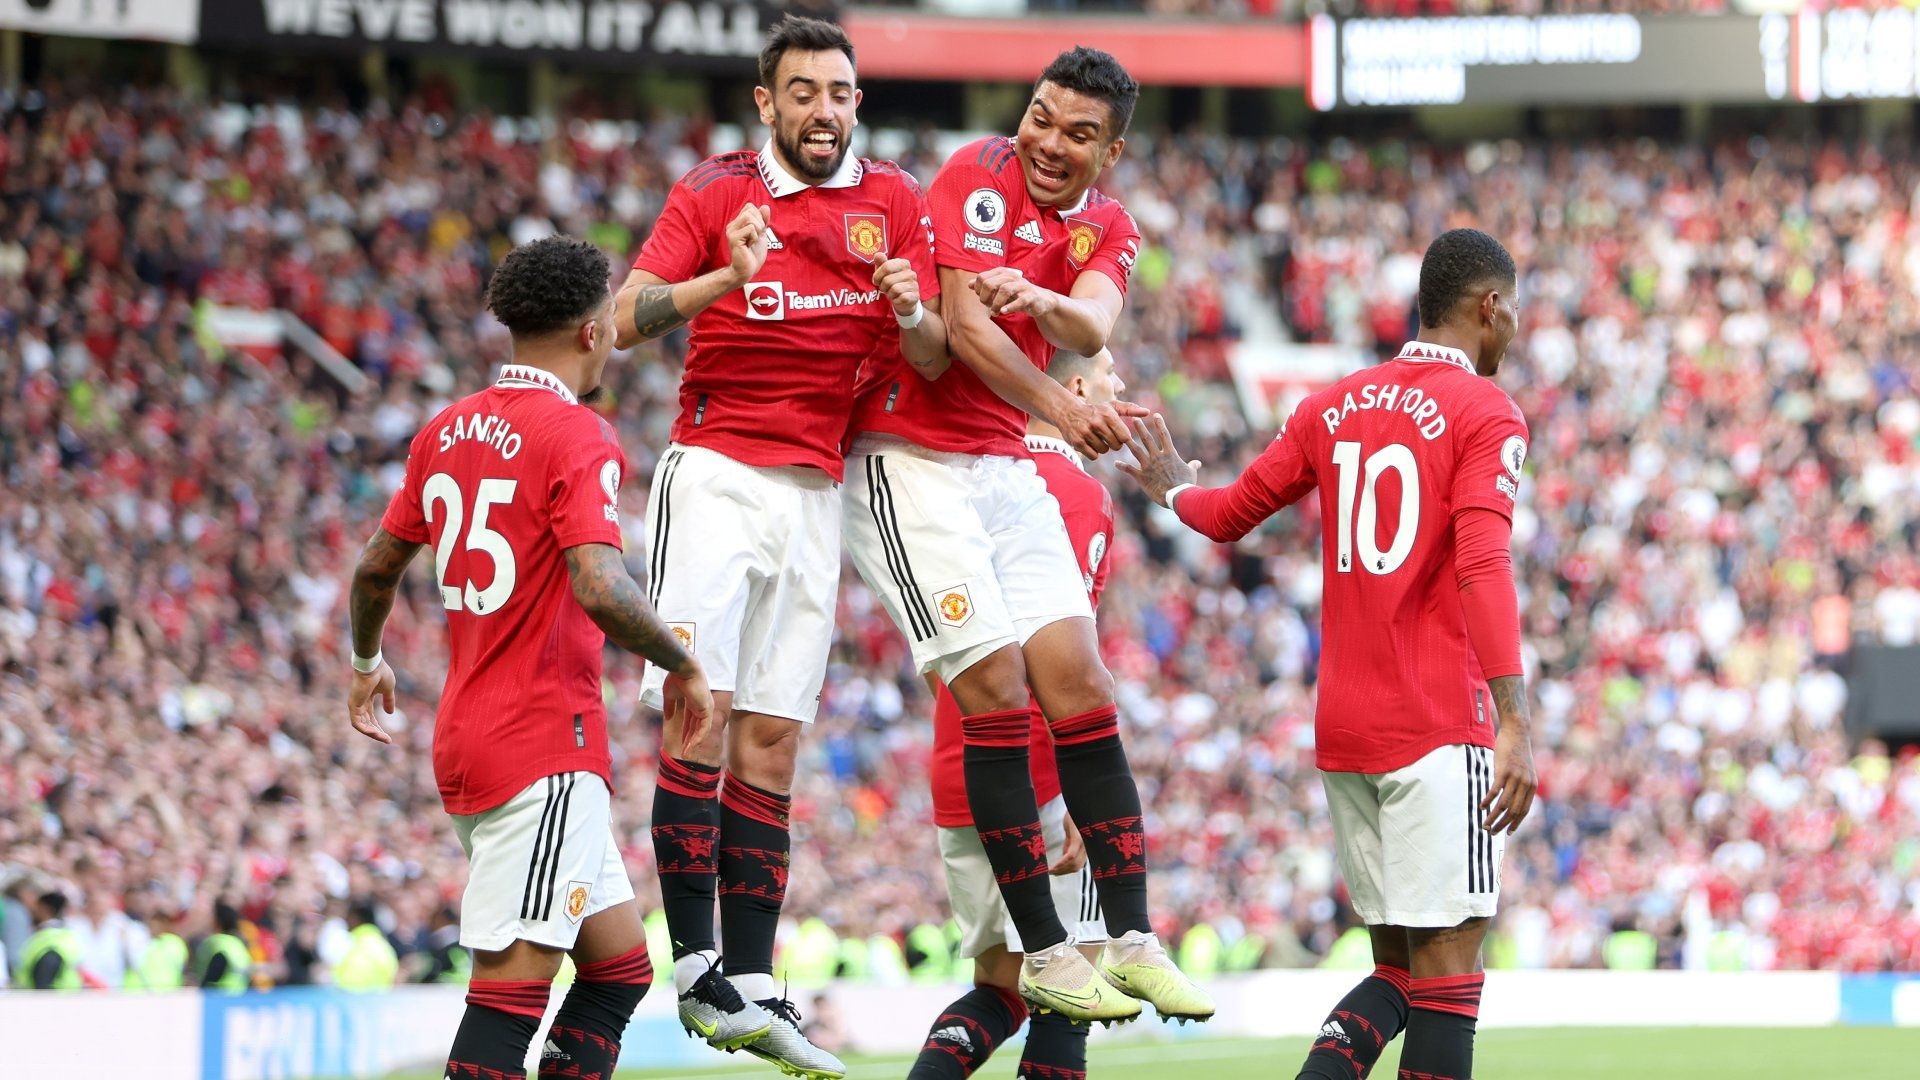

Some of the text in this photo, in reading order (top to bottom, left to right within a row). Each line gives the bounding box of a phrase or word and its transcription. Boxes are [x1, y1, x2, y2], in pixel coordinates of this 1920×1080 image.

[443, 0, 584, 48] WON
[586, 0, 654, 51] IT
[653, 1, 771, 57] ALL
[965, 233, 1001, 249] No room
[1014, 230, 1044, 244] adidas
[784, 288, 881, 310] TeamViewer
[1322, 384, 1446, 440] RASHFORD
[1332, 441, 1420, 575] 10
[422, 472, 518, 616] 25
[930, 1033, 976, 1052] adidas
[541, 1051, 571, 1060] das
